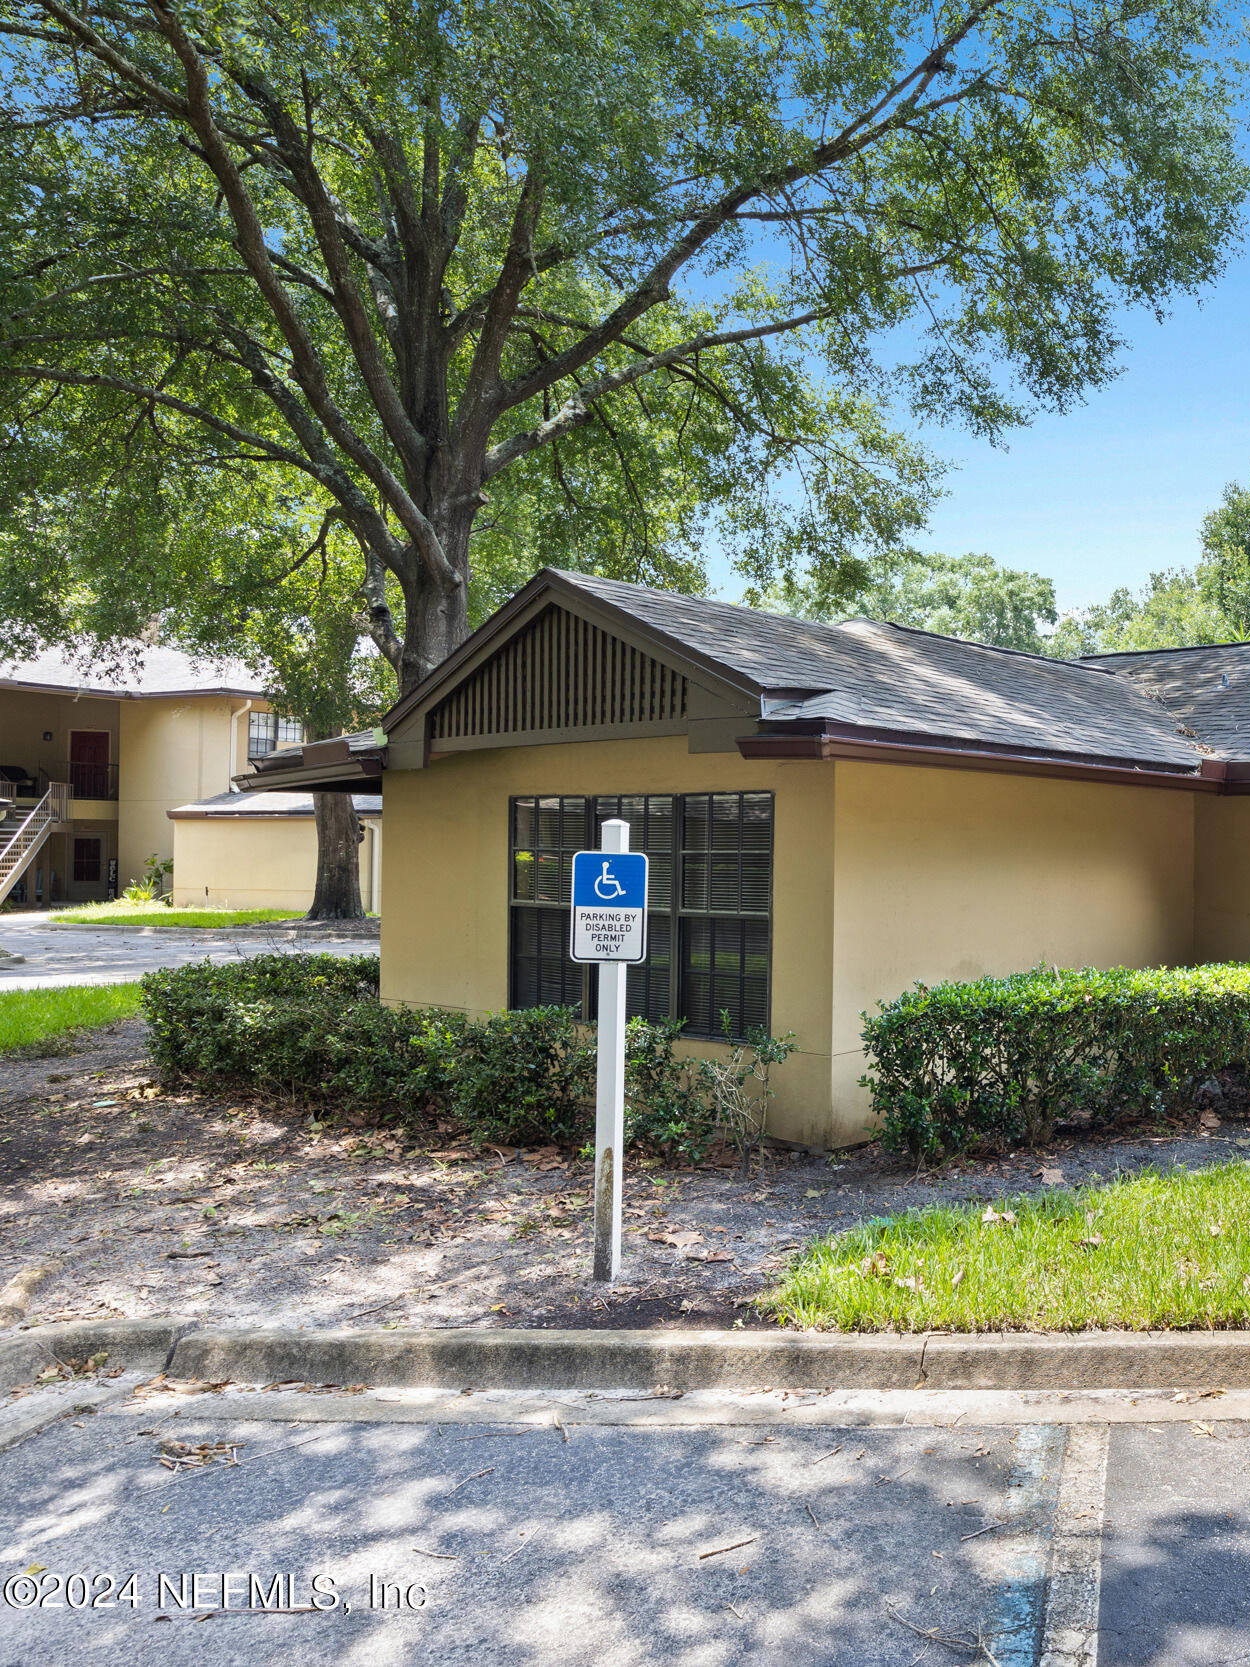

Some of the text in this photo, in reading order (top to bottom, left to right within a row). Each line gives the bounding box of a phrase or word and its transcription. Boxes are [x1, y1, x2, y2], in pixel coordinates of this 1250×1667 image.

[580, 912, 637, 922] PARKING BY
[585, 923, 632, 932] DISABLED
[591, 933, 625, 942] PERMIT
[595, 943, 620, 952] ONLY
